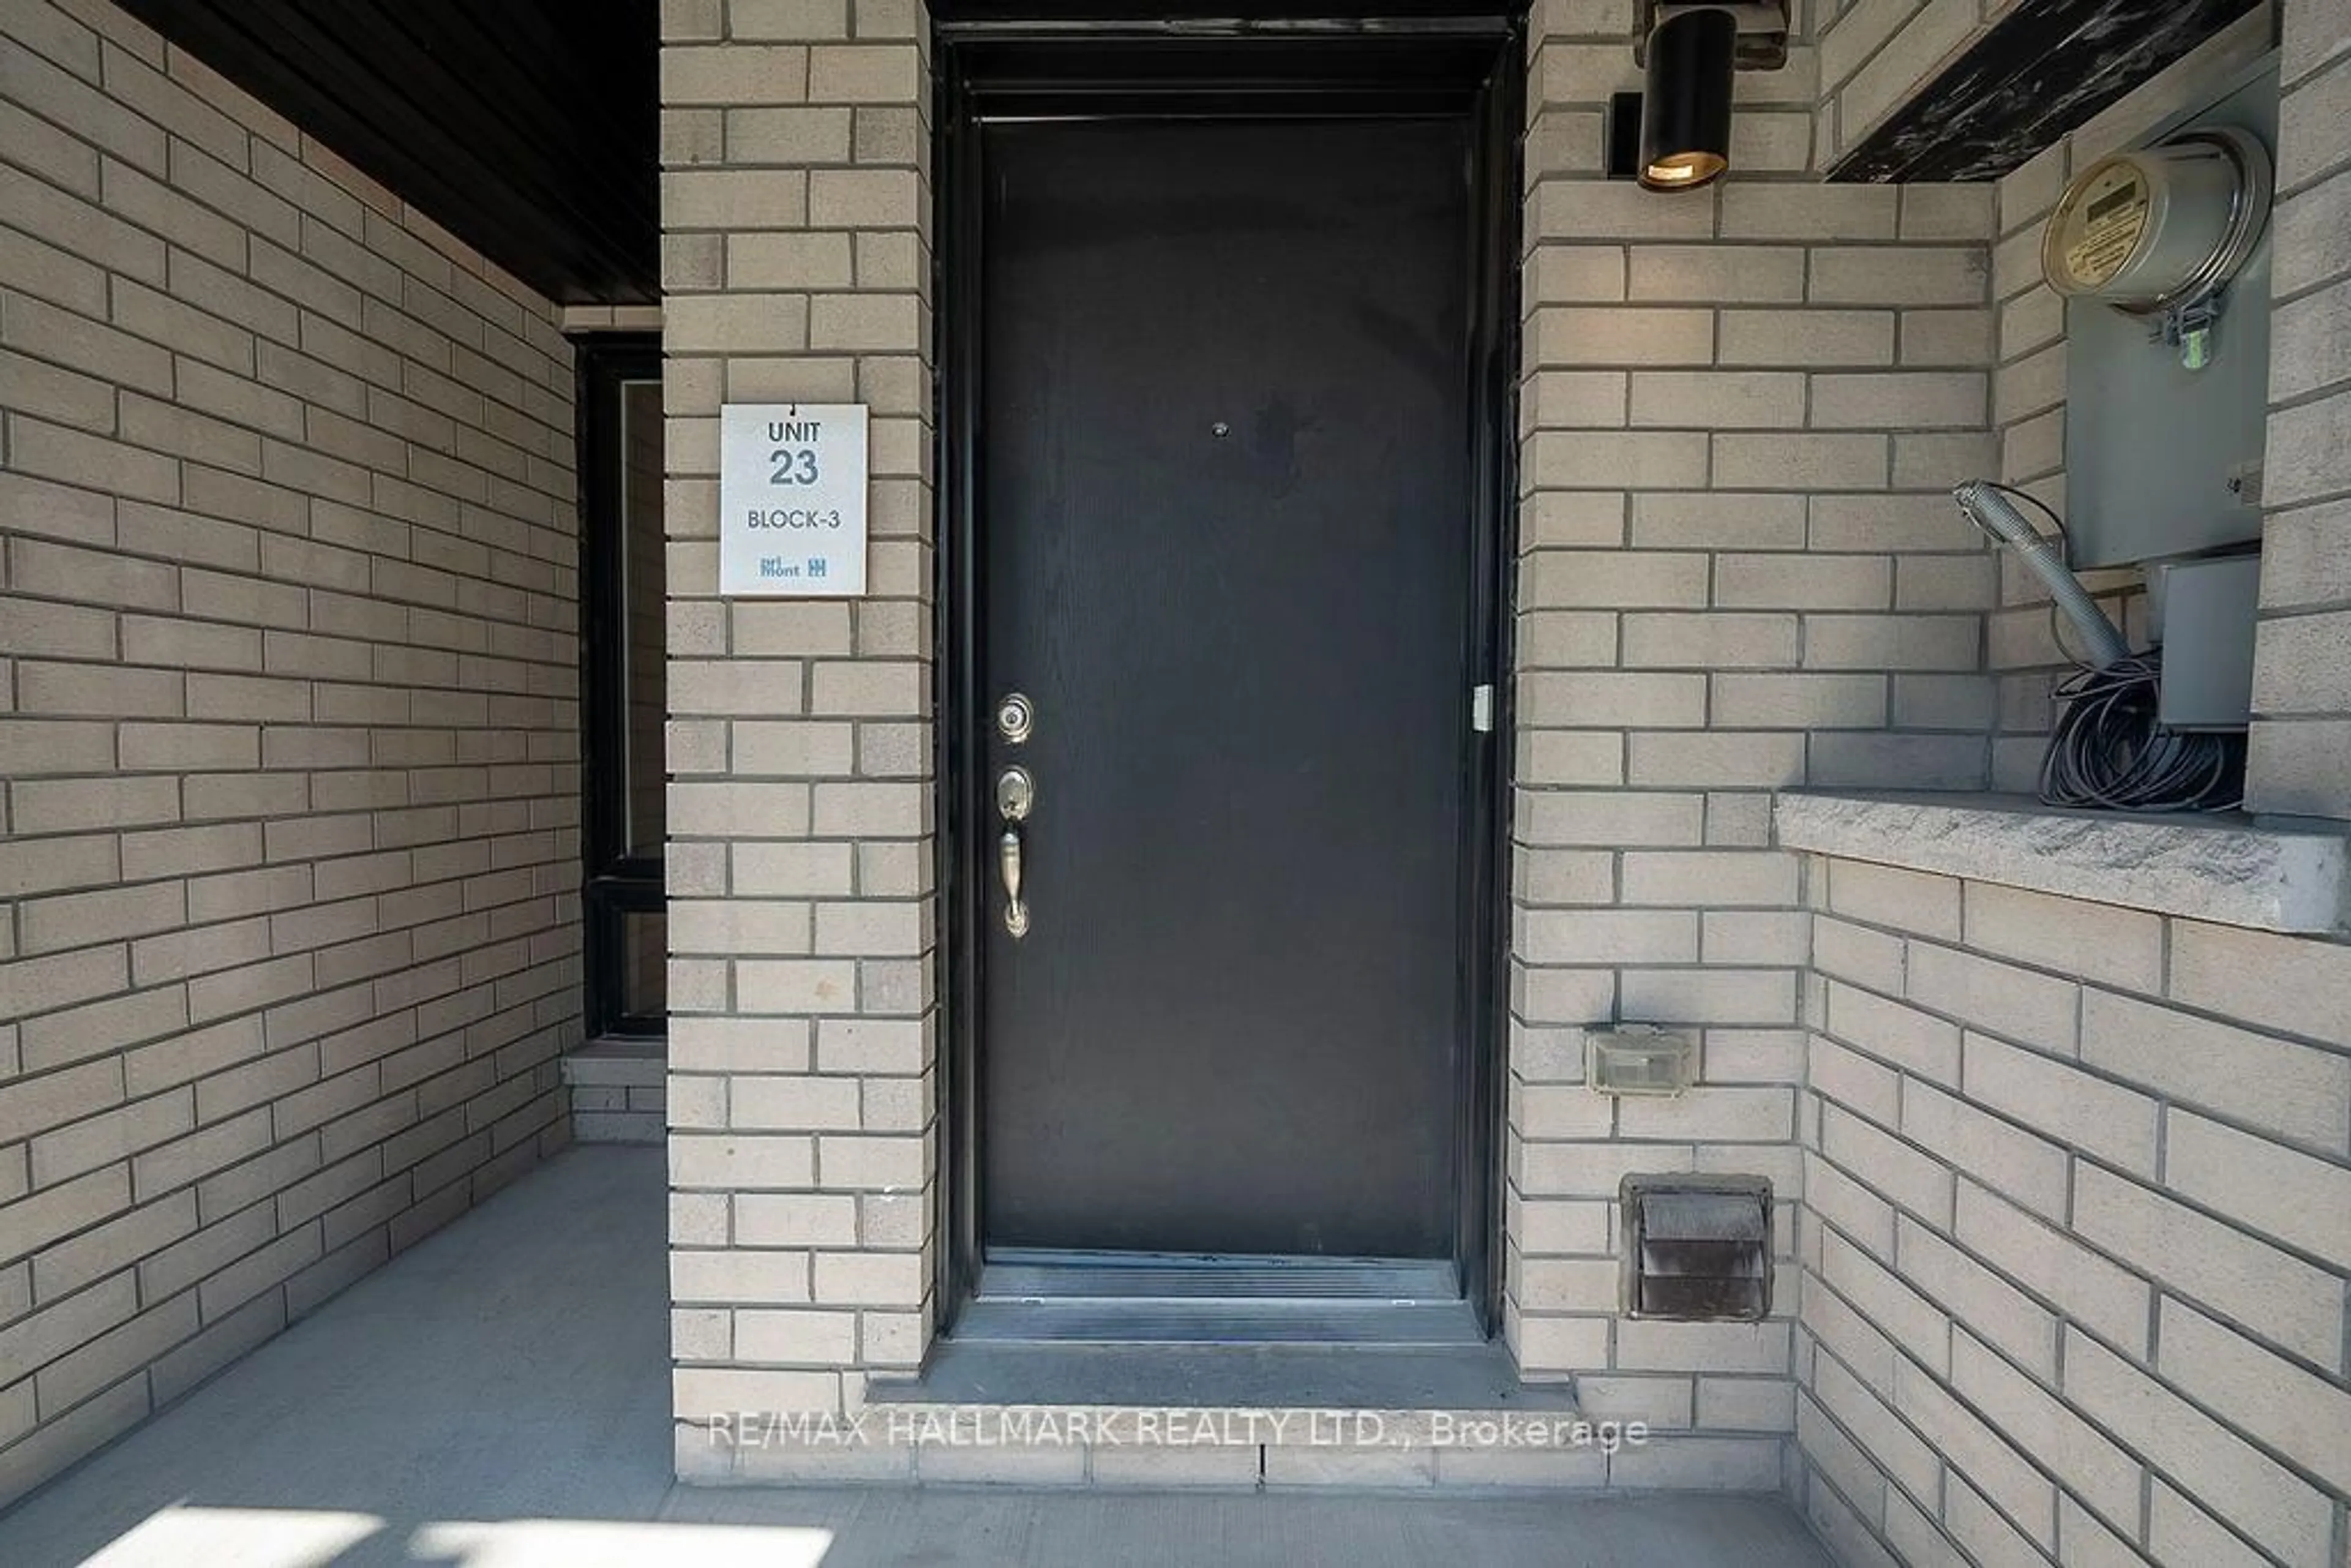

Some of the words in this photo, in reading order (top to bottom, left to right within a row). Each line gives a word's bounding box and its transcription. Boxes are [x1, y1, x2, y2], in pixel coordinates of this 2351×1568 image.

[768, 422, 820, 441] UNIT
[770, 449, 819, 485] 23
[748, 511, 840, 528] BLOCK-3
